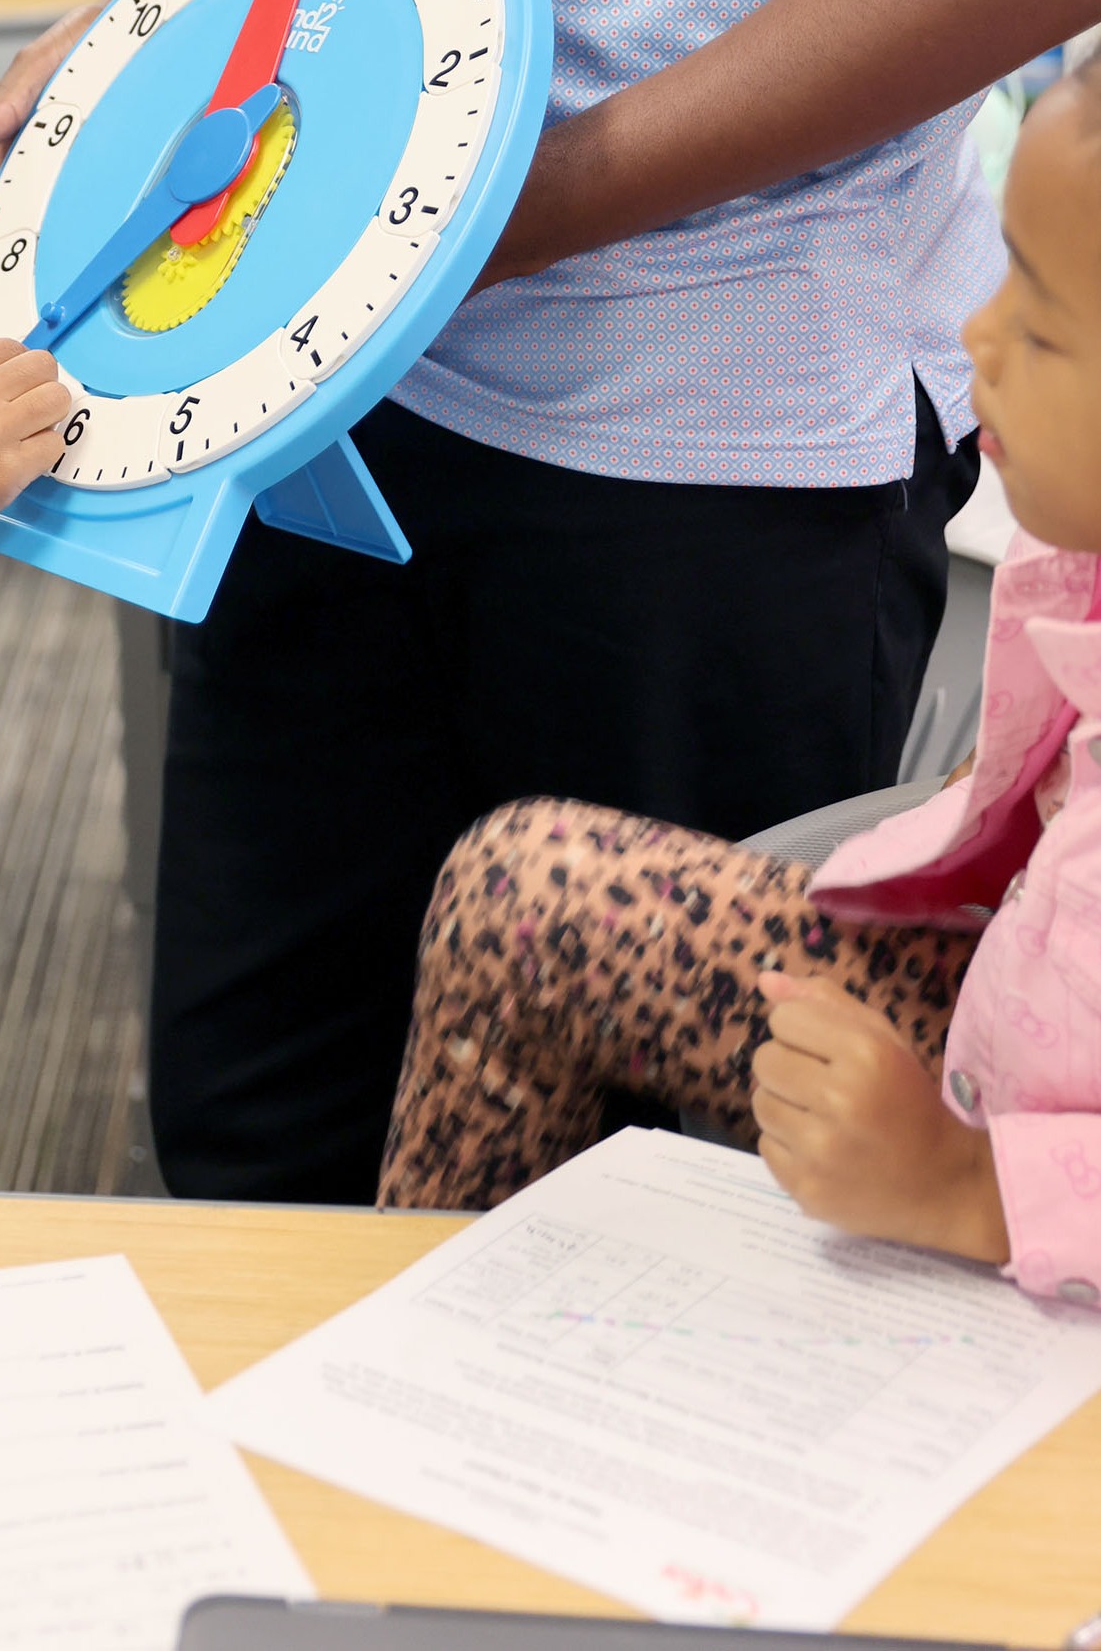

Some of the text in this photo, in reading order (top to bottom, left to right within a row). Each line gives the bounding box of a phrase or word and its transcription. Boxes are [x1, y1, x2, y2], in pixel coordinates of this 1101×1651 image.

[129, 2, 162, 37] 10
[429, 49, 462, 88] 2
[48, 114, 74, 147] 9
[389, 186, 419, 225] 3
[1, 238, 27, 272] 8
[289, 315, 319, 352] 4
[63, 409, 90, 447] 6
[169, 396, 201, 435] 5
